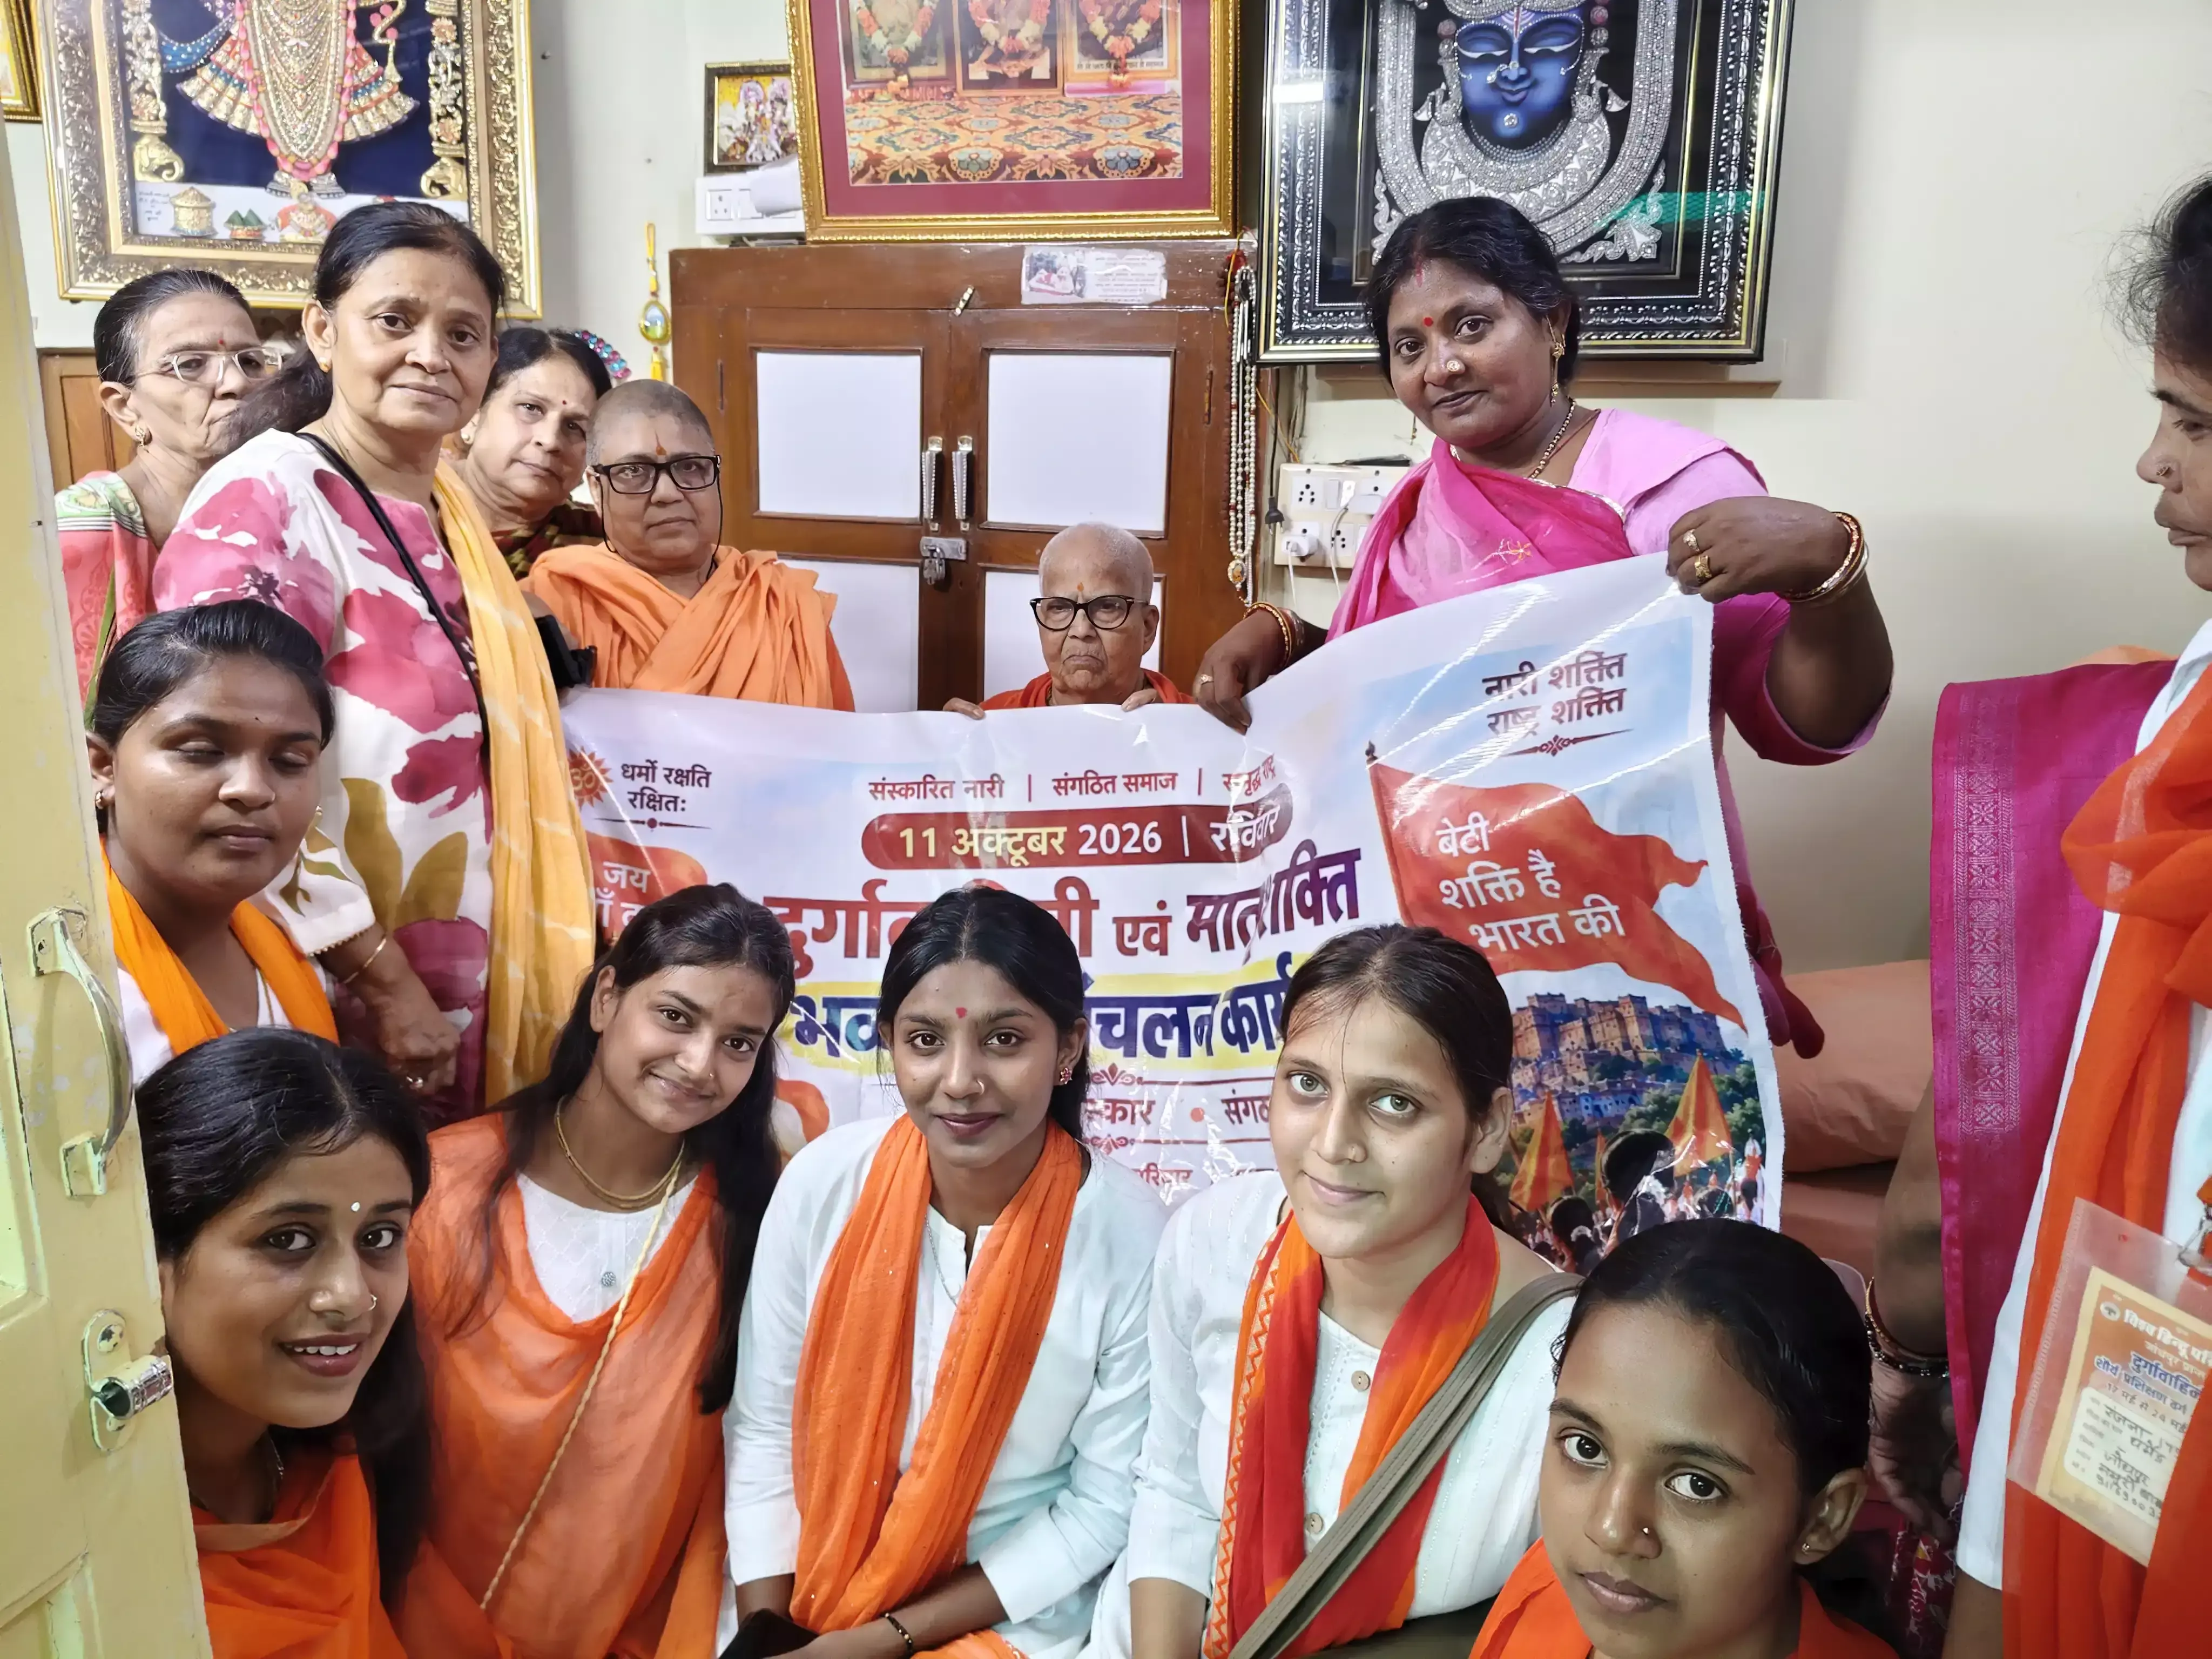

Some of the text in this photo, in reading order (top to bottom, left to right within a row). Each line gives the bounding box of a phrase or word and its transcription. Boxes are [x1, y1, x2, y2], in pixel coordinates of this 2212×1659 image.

[1482, 660, 1539, 699] नारी
[621, 759, 712, 788] धर्मो रक्षति
[868, 774, 955, 800] संस्कारित
[962, 773, 1004, 798] नारी
[1052, 770, 1117, 796] संगठित
[1122, 772, 1178, 792] समाज
[899, 827, 936, 858] 11
[951, 826, 1067, 867] अक्टूबर
[1078, 821, 1162, 855] 2026
[1436, 811, 1491, 858] बेटी
[603, 861, 651, 893] जय
[1439, 848, 1562, 910] शक्ति है
[1113, 900, 1171, 957] एवं
[1469, 894, 1626, 954] भारत की
